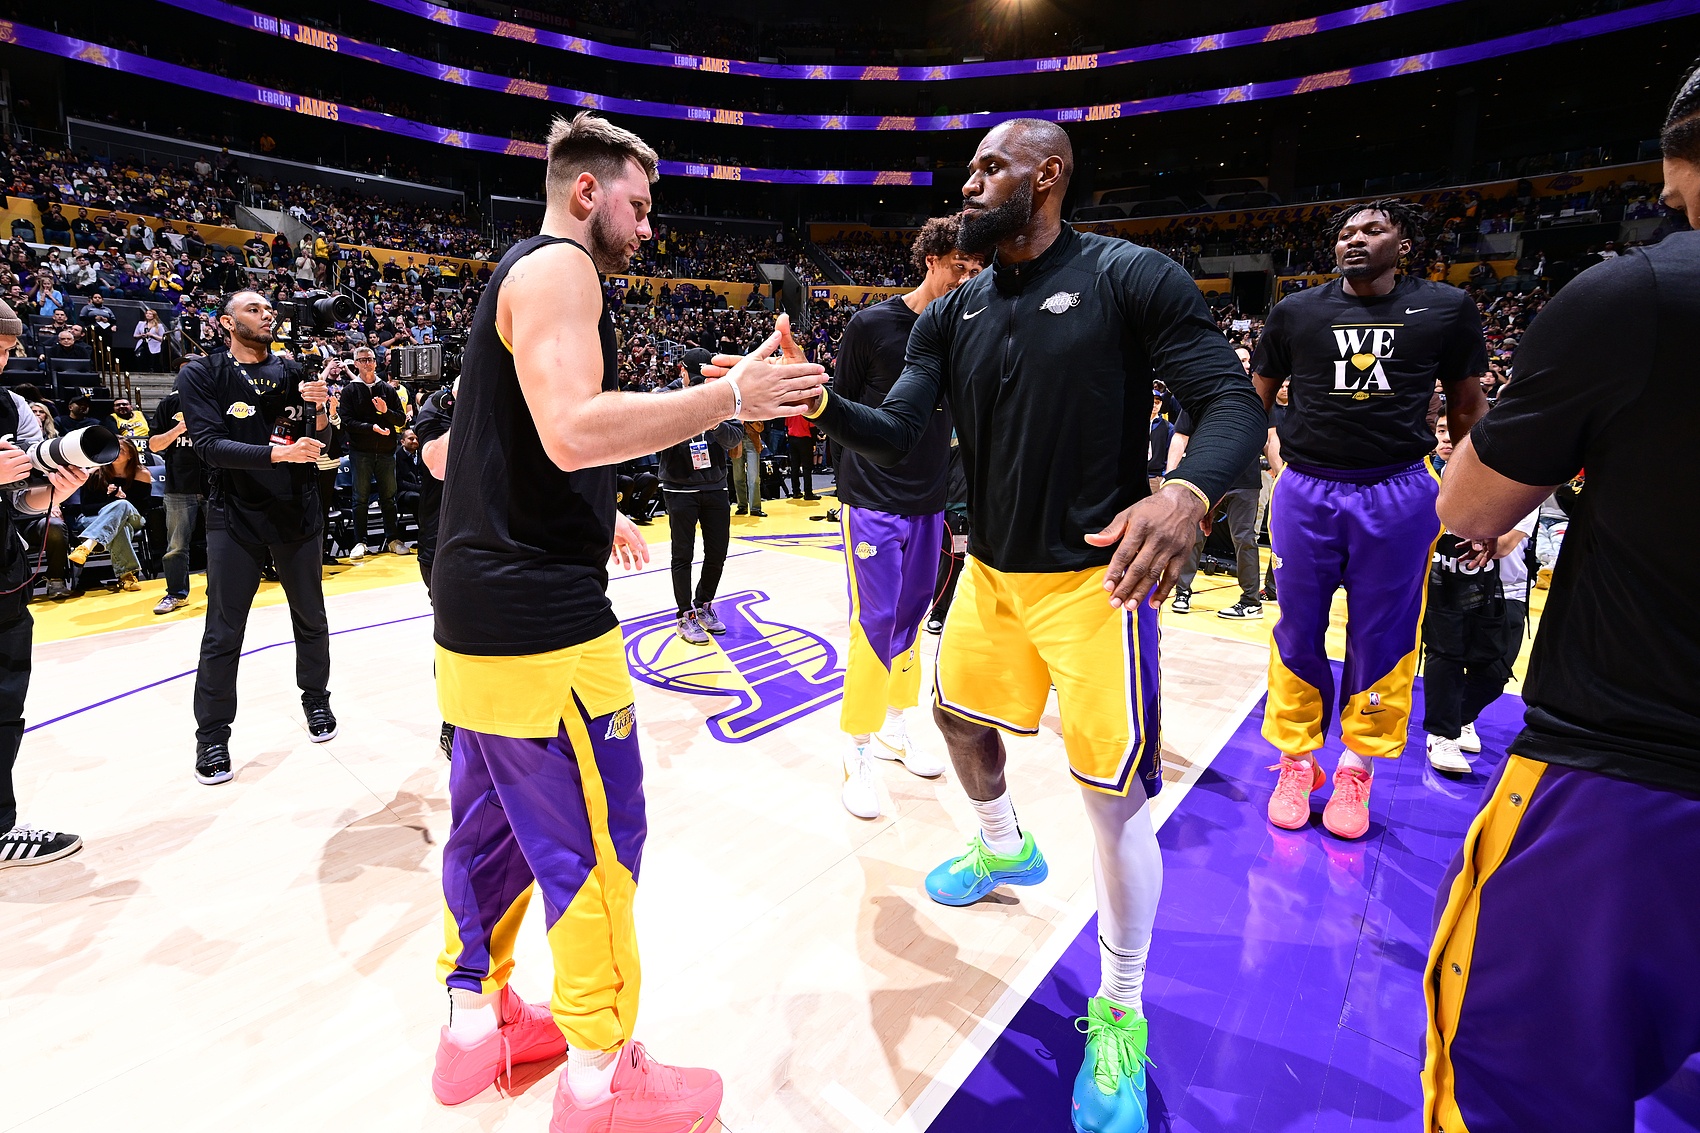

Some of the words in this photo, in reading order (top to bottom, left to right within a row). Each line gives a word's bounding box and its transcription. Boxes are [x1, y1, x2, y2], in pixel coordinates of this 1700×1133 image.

[517, 9, 571, 28] TOSHIBA
[254, 15, 290, 36] LEBRON
[294, 25, 338, 52] JAMES
[674, 55, 698, 67] LEBRON
[699, 57, 730, 74] JAMES
[1036, 59, 1062, 70] LEBRON
[1063, 54, 1098, 71] JAMES
[258, 89, 292, 108] LEBRON
[295, 96, 339, 121] JAMES
[1057, 109, 1083, 120] LEBRON
[1084, 104, 1121, 121] JAMES
[687, 108, 711, 120] LEBRON
[713, 109, 744, 126] JAMES
[685, 165, 709, 176] LEBRON
[711, 165, 742, 181] JAMES
[615, 278, 626, 288] 14
[815, 289, 828, 297] 114
[1038, 292, 1081, 311] LAKERS
[1332, 328, 1395, 359] WE
[253, 378, 277, 389] KERS
[1333, 359, 1392, 391] LA
